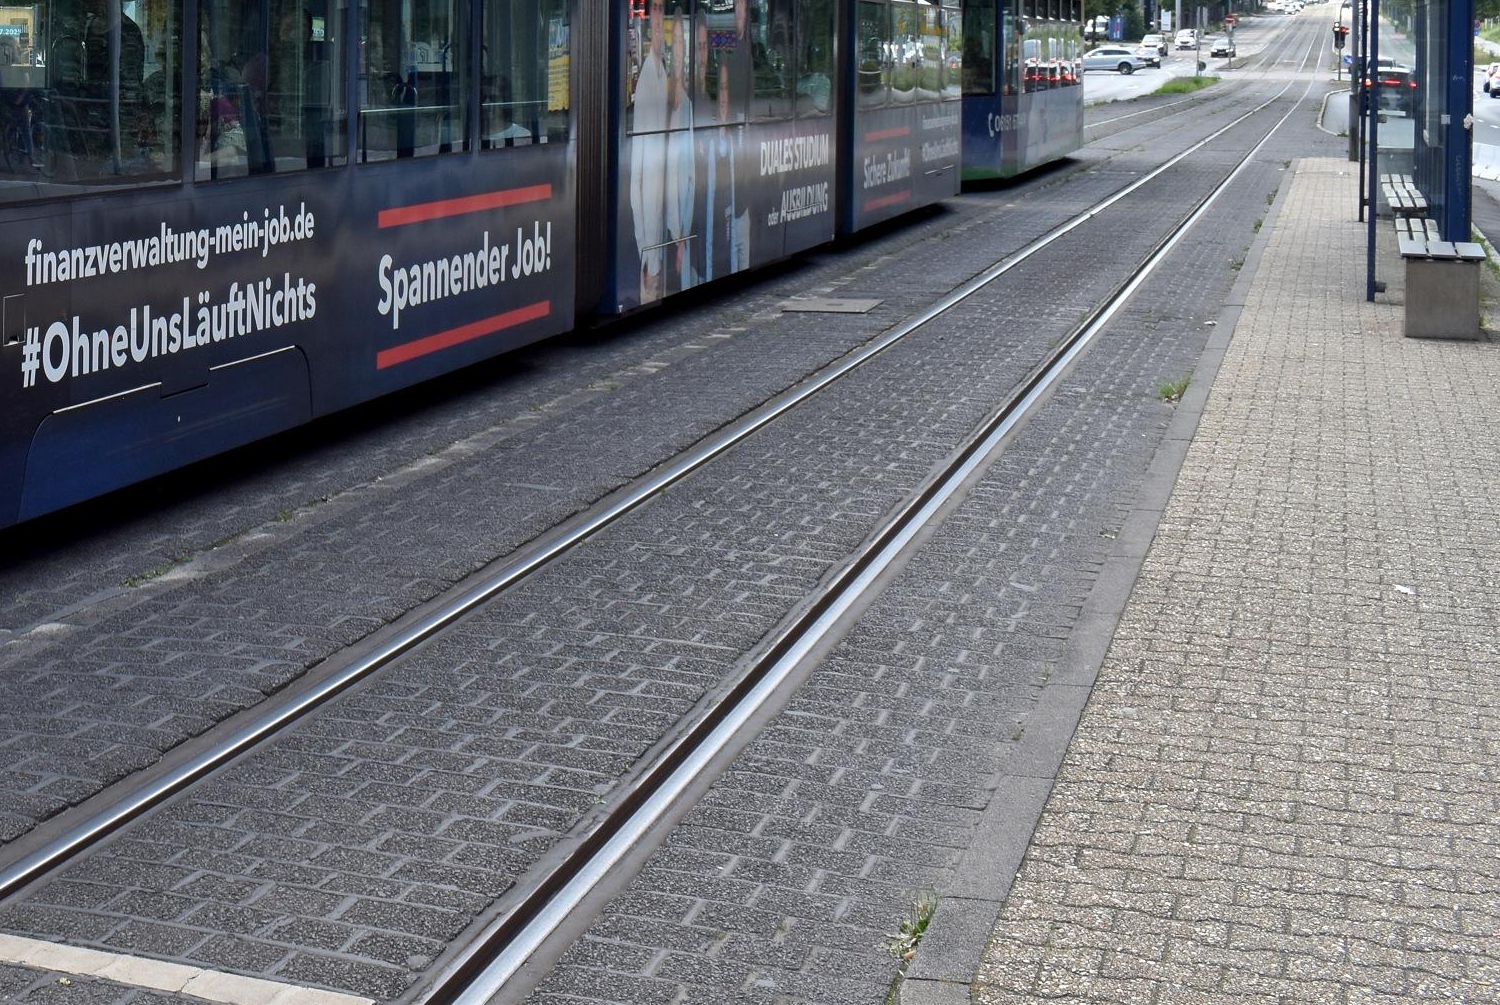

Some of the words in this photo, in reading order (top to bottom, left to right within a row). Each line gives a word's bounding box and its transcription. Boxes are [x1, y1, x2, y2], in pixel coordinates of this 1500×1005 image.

[760, 137, 793, 176] DUALES
[794, 134, 828, 170] STUDIUM
[24, 202, 315, 286] finanzverwaltung-mein-job.de
[780, 181, 828, 223] AUSBILDUNG
[377, 231, 509, 329] Spannender
[511, 222, 552, 281] Job!
[21, 273, 316, 388] #OhneUnsLäuftNichts
